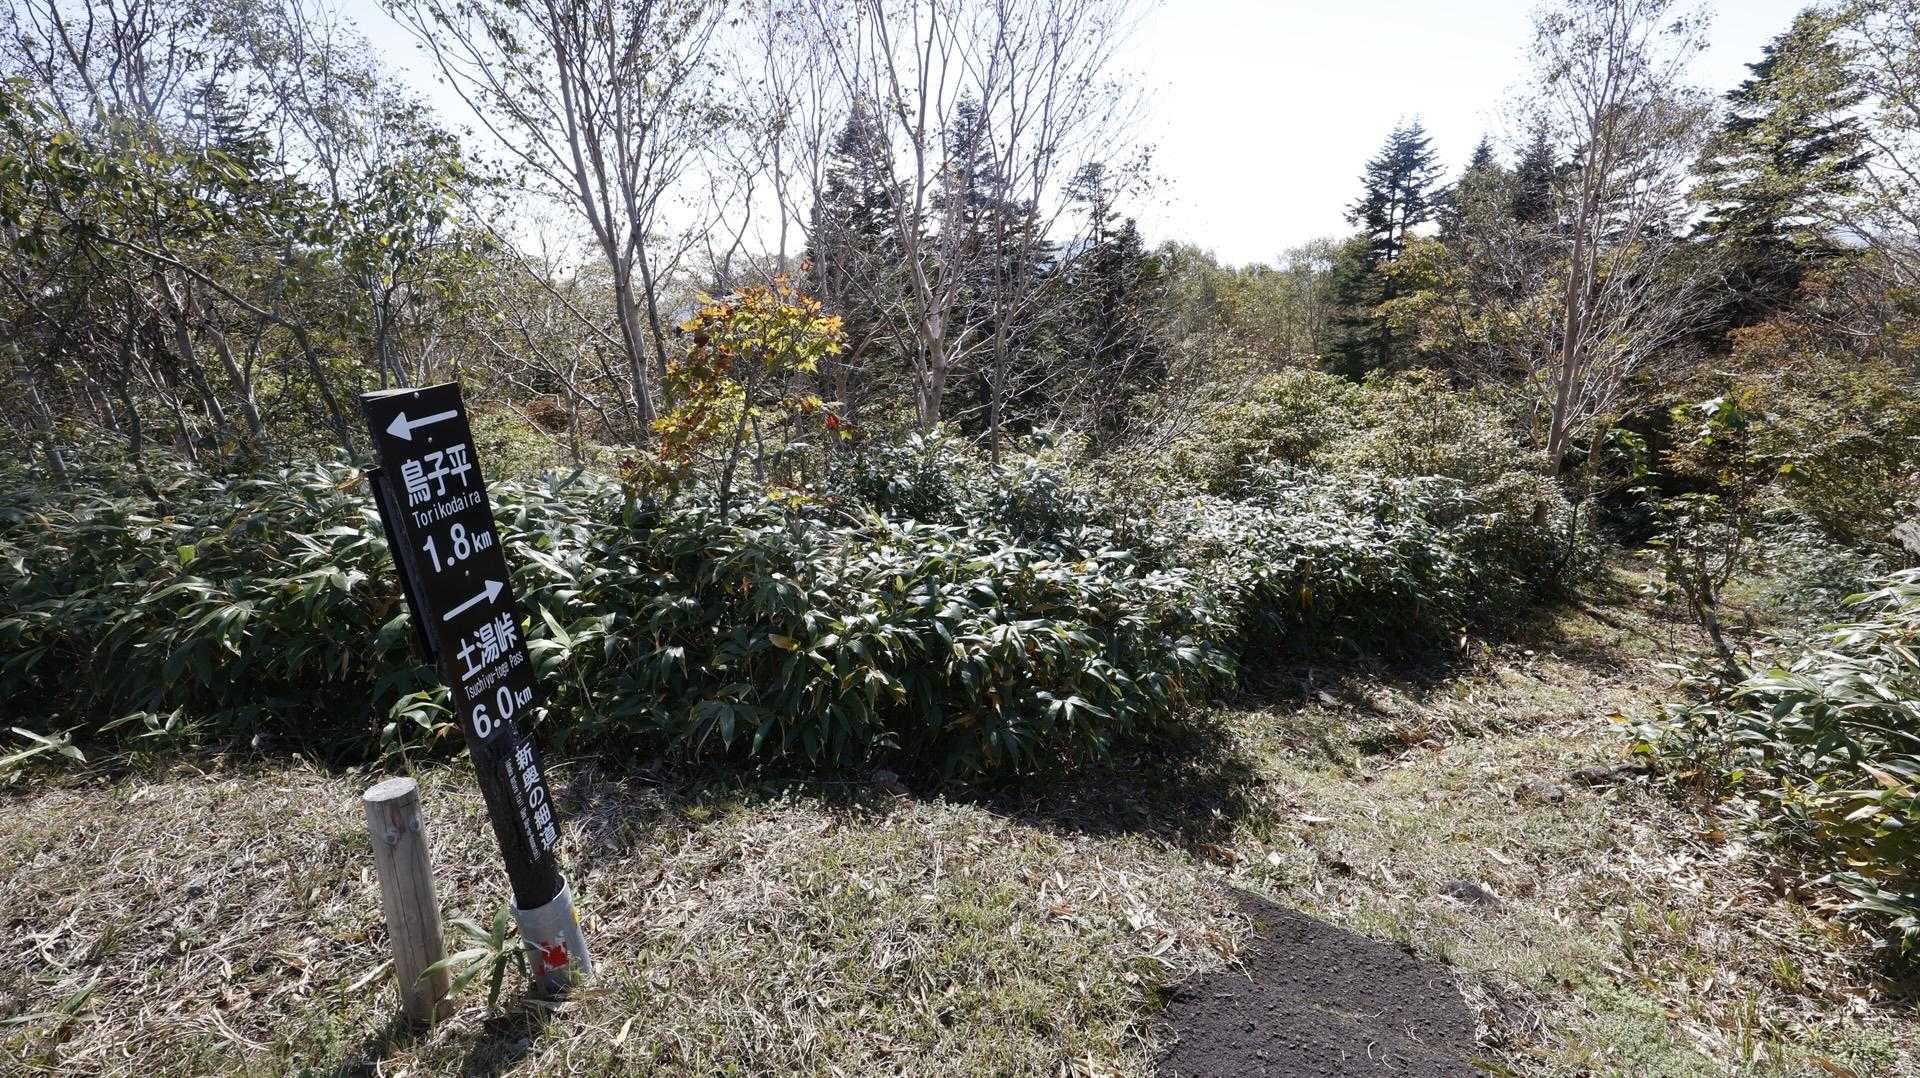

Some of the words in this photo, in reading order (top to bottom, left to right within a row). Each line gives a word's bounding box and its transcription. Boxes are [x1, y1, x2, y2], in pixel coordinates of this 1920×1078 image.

[401, 444, 472, 507] 鳥子平
[412, 490, 481, 528] Torikodaira
[423, 523, 471, 573] 1.8
[471, 530, 493, 553] km
[456, 611, 517, 682] 土湯峠
[472, 686, 514, 738] 6.0
[514, 686, 533, 709] km
[515, 742, 558, 851] 新奥の細道
